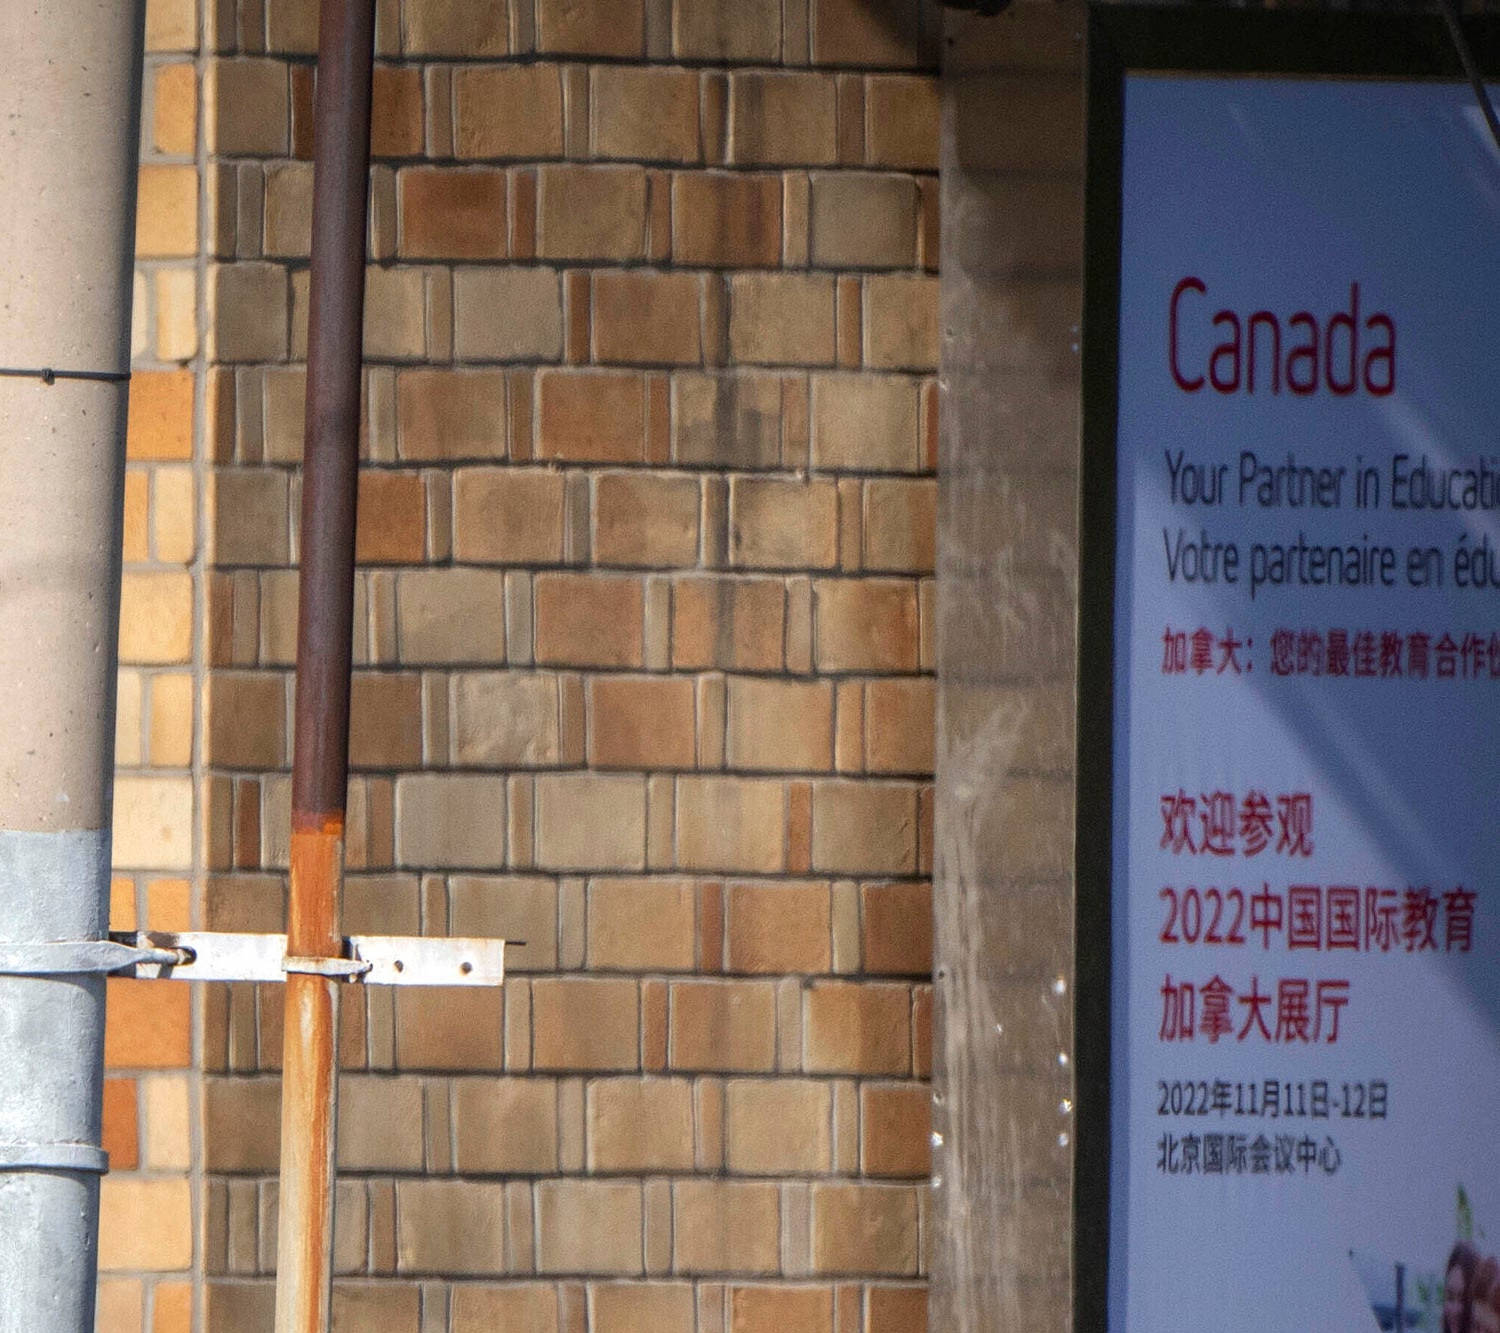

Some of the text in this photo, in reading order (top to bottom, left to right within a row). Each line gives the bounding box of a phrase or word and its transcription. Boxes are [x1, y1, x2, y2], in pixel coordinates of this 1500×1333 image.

[1168, 276, 1397, 396] Canada
[1164, 450, 1500, 510] Your Partner in Educati
[1162, 528, 1239, 584] Votre
[1250, 530, 1395, 600] partenaire
[1407, 546, 1443, 586] en
[1159, 788, 1314, 857] 欢迎参观
[1158, 882, 1478, 952] 2022中国国际教育
[1159, 973, 1350, 1044] 加拿大展厅
[1157, 1078, 1388, 1120] 2022年11月11日-12日
[1157, 1131, 1341, 1175] 北京国际会议中心
